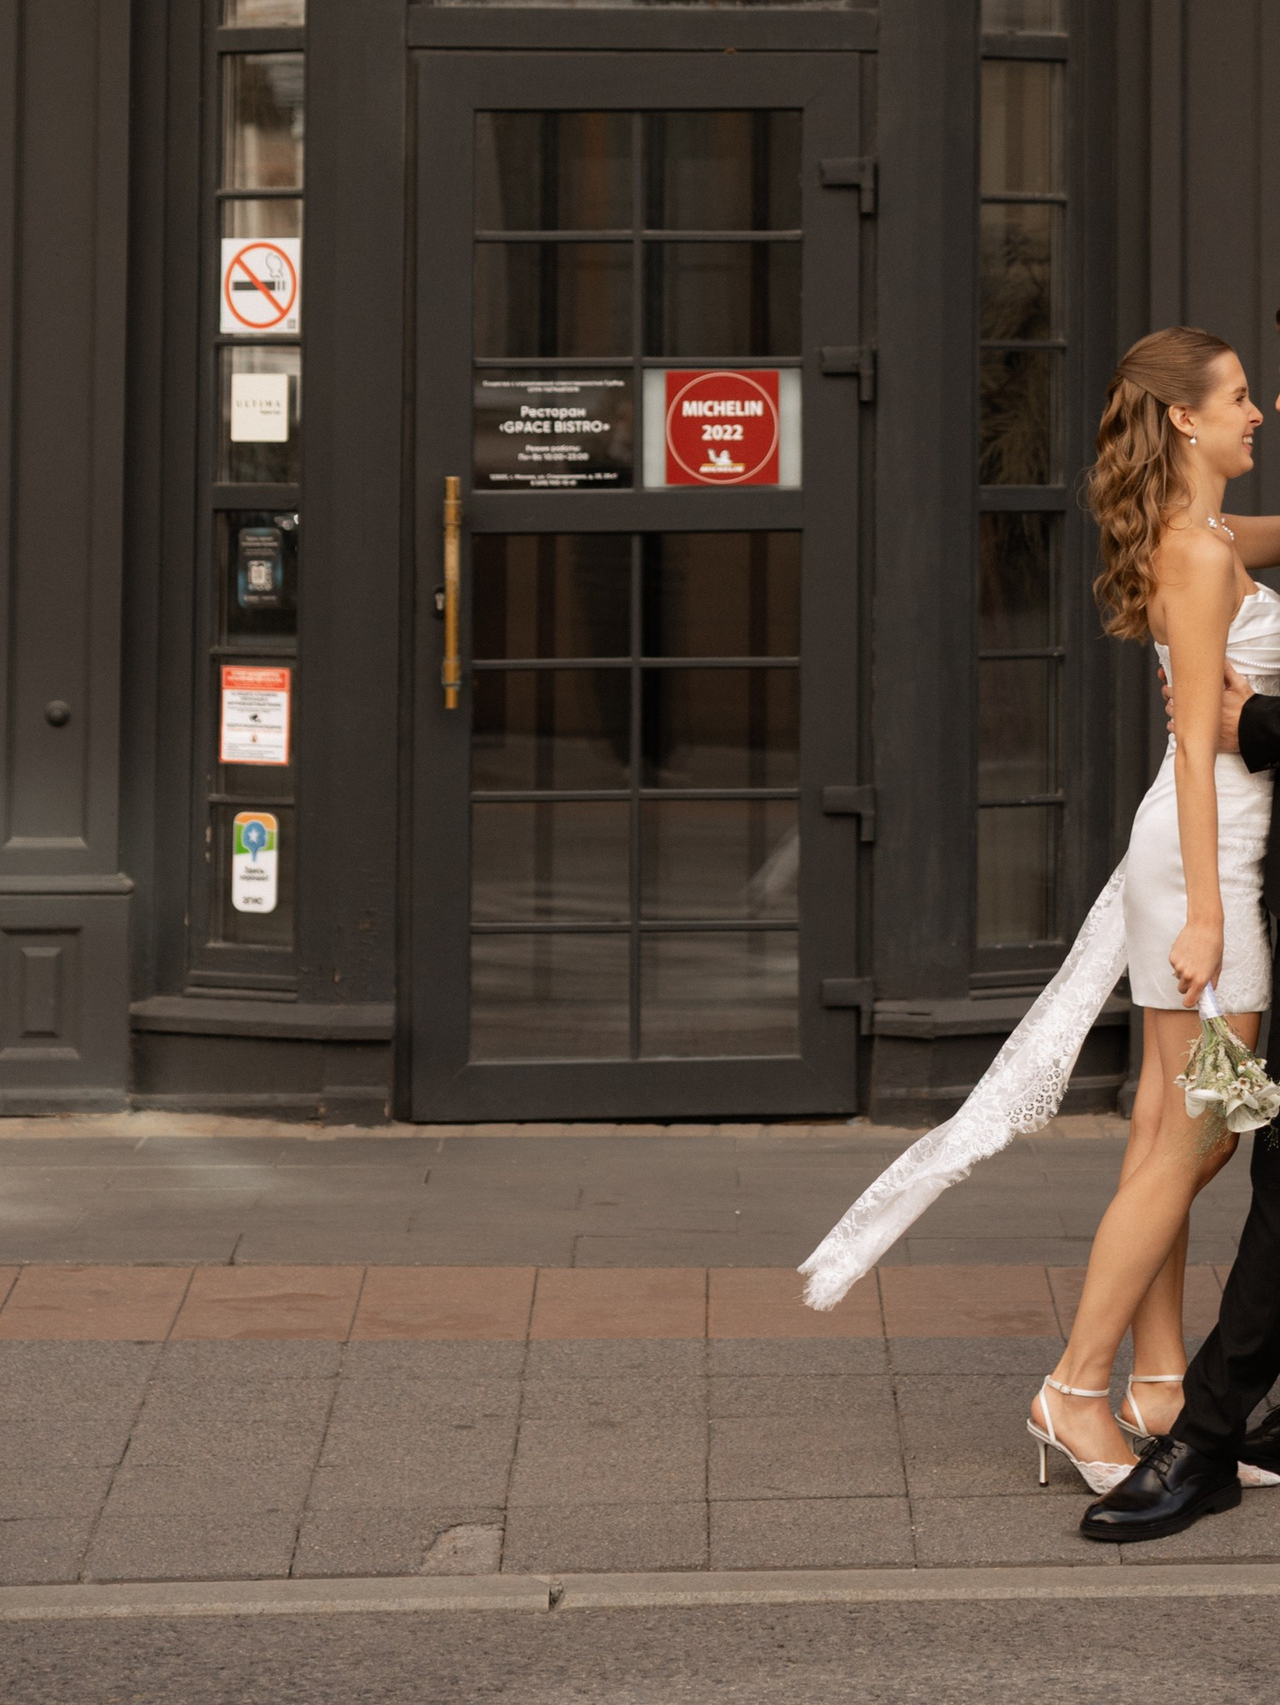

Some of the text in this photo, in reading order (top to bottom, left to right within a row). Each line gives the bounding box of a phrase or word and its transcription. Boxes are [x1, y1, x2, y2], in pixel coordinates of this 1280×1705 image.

[520, 405, 586, 419] Ресторан
[682, 399, 763, 418] MICHELIN
[701, 424, 744, 441] 2022
